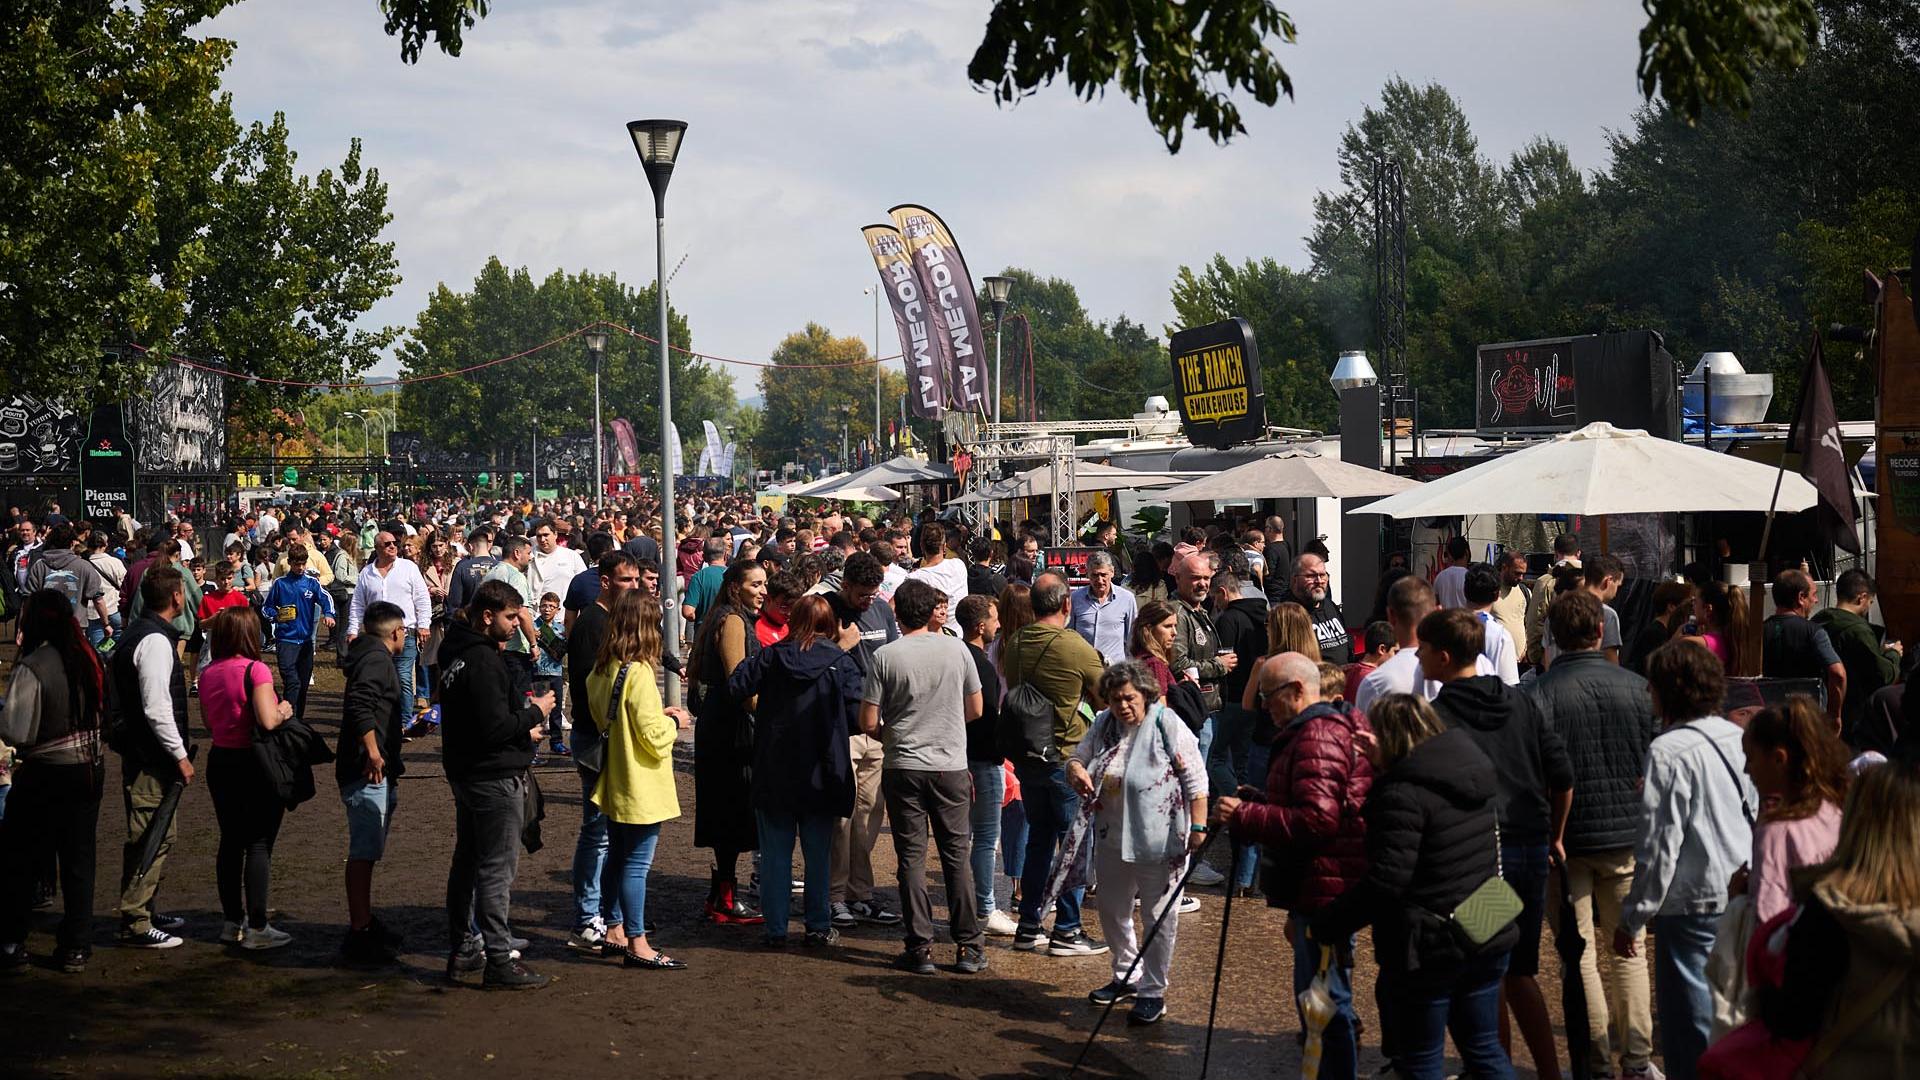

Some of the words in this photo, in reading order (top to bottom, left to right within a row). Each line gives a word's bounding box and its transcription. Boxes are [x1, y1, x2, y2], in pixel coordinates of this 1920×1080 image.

[1179, 355, 1202, 393] THE
[1203, 346, 1245, 390] RANCH
[1189, 391, 1246, 416] SMOKEHOUSE
[1890, 458, 1920, 468] RECOGE
[84, 489, 127, 501] Piensa
[87, 505, 113, 517] Ver
